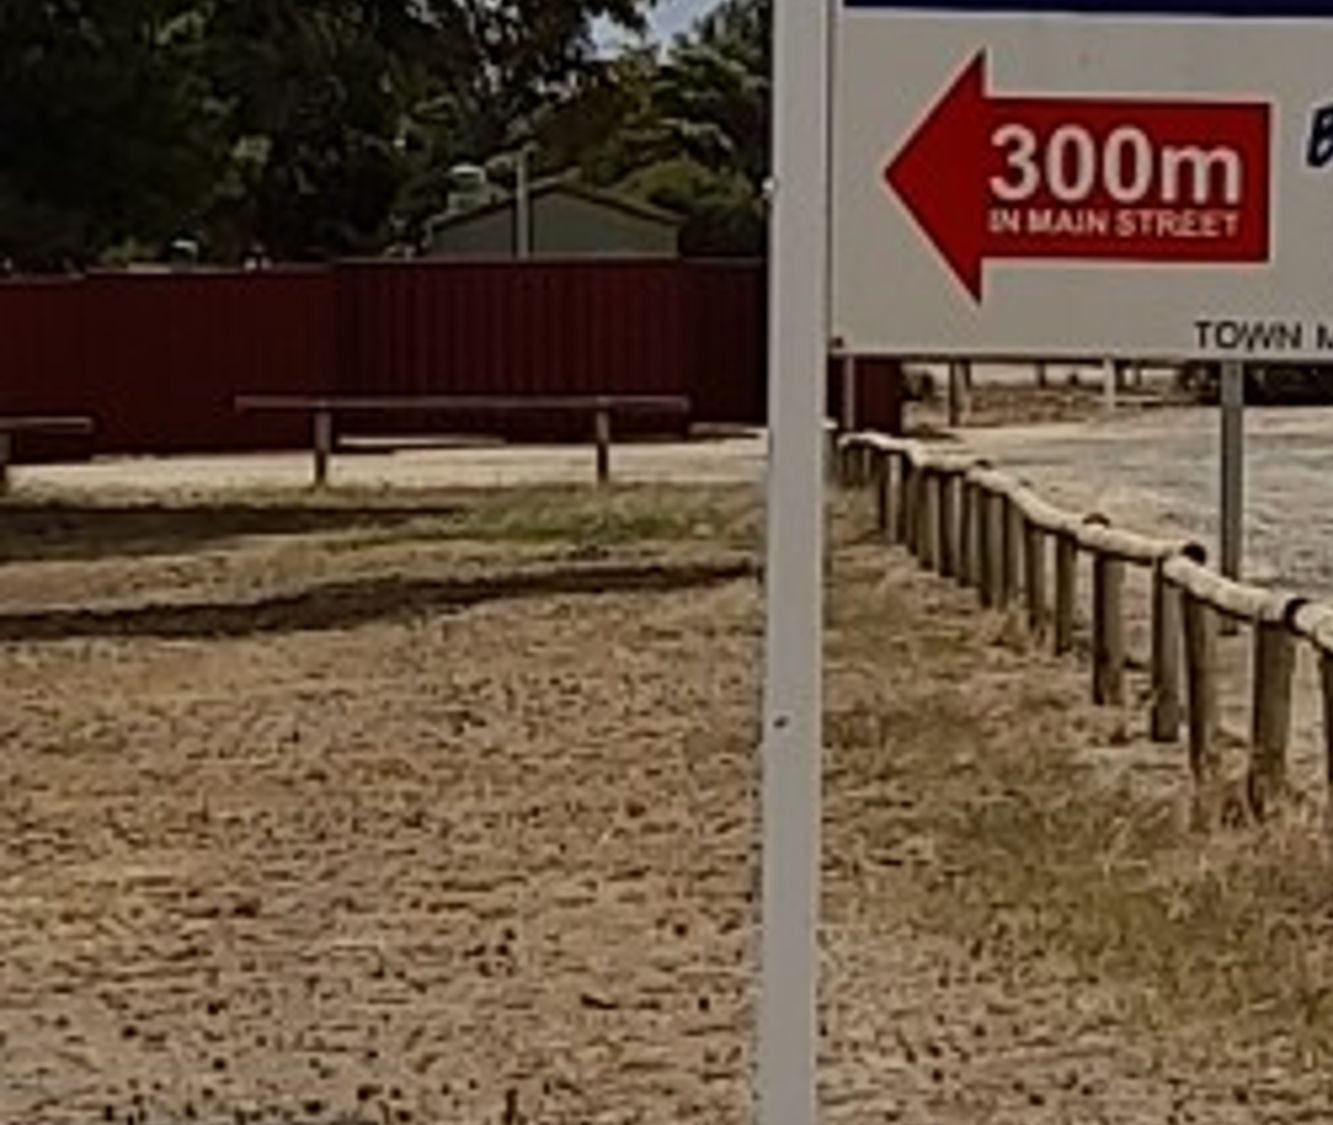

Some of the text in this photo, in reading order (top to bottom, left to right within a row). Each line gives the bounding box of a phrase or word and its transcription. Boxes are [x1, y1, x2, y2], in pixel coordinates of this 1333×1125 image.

[989, 123, 1242, 203] 300m
[988, 209, 1240, 238] IN MAIN STREET
[1194, 321, 1302, 350] TOWN
